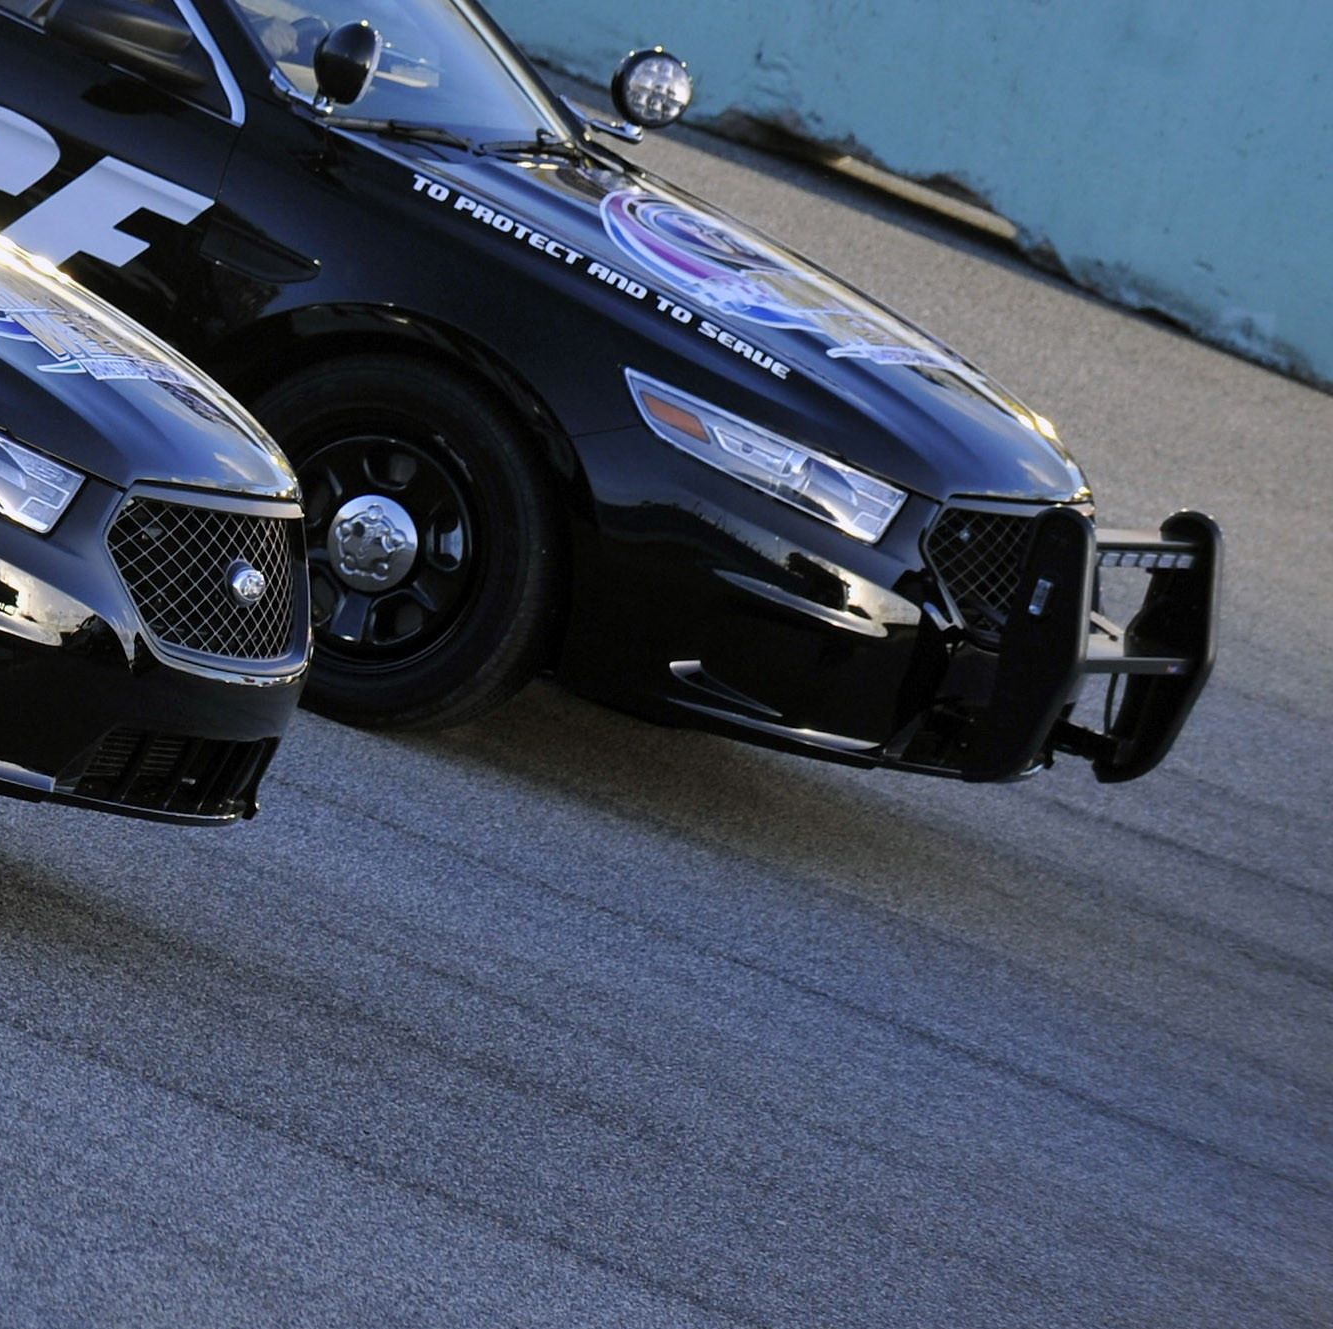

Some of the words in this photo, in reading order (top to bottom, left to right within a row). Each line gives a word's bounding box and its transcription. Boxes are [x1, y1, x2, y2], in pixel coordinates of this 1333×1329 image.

[413, 174, 450, 202] TO
[454, 195, 583, 264] PROTECT
[587, 262, 648, 300] AND
[656, 296, 693, 324] TO
[697, 322, 791, 380] SERVE
